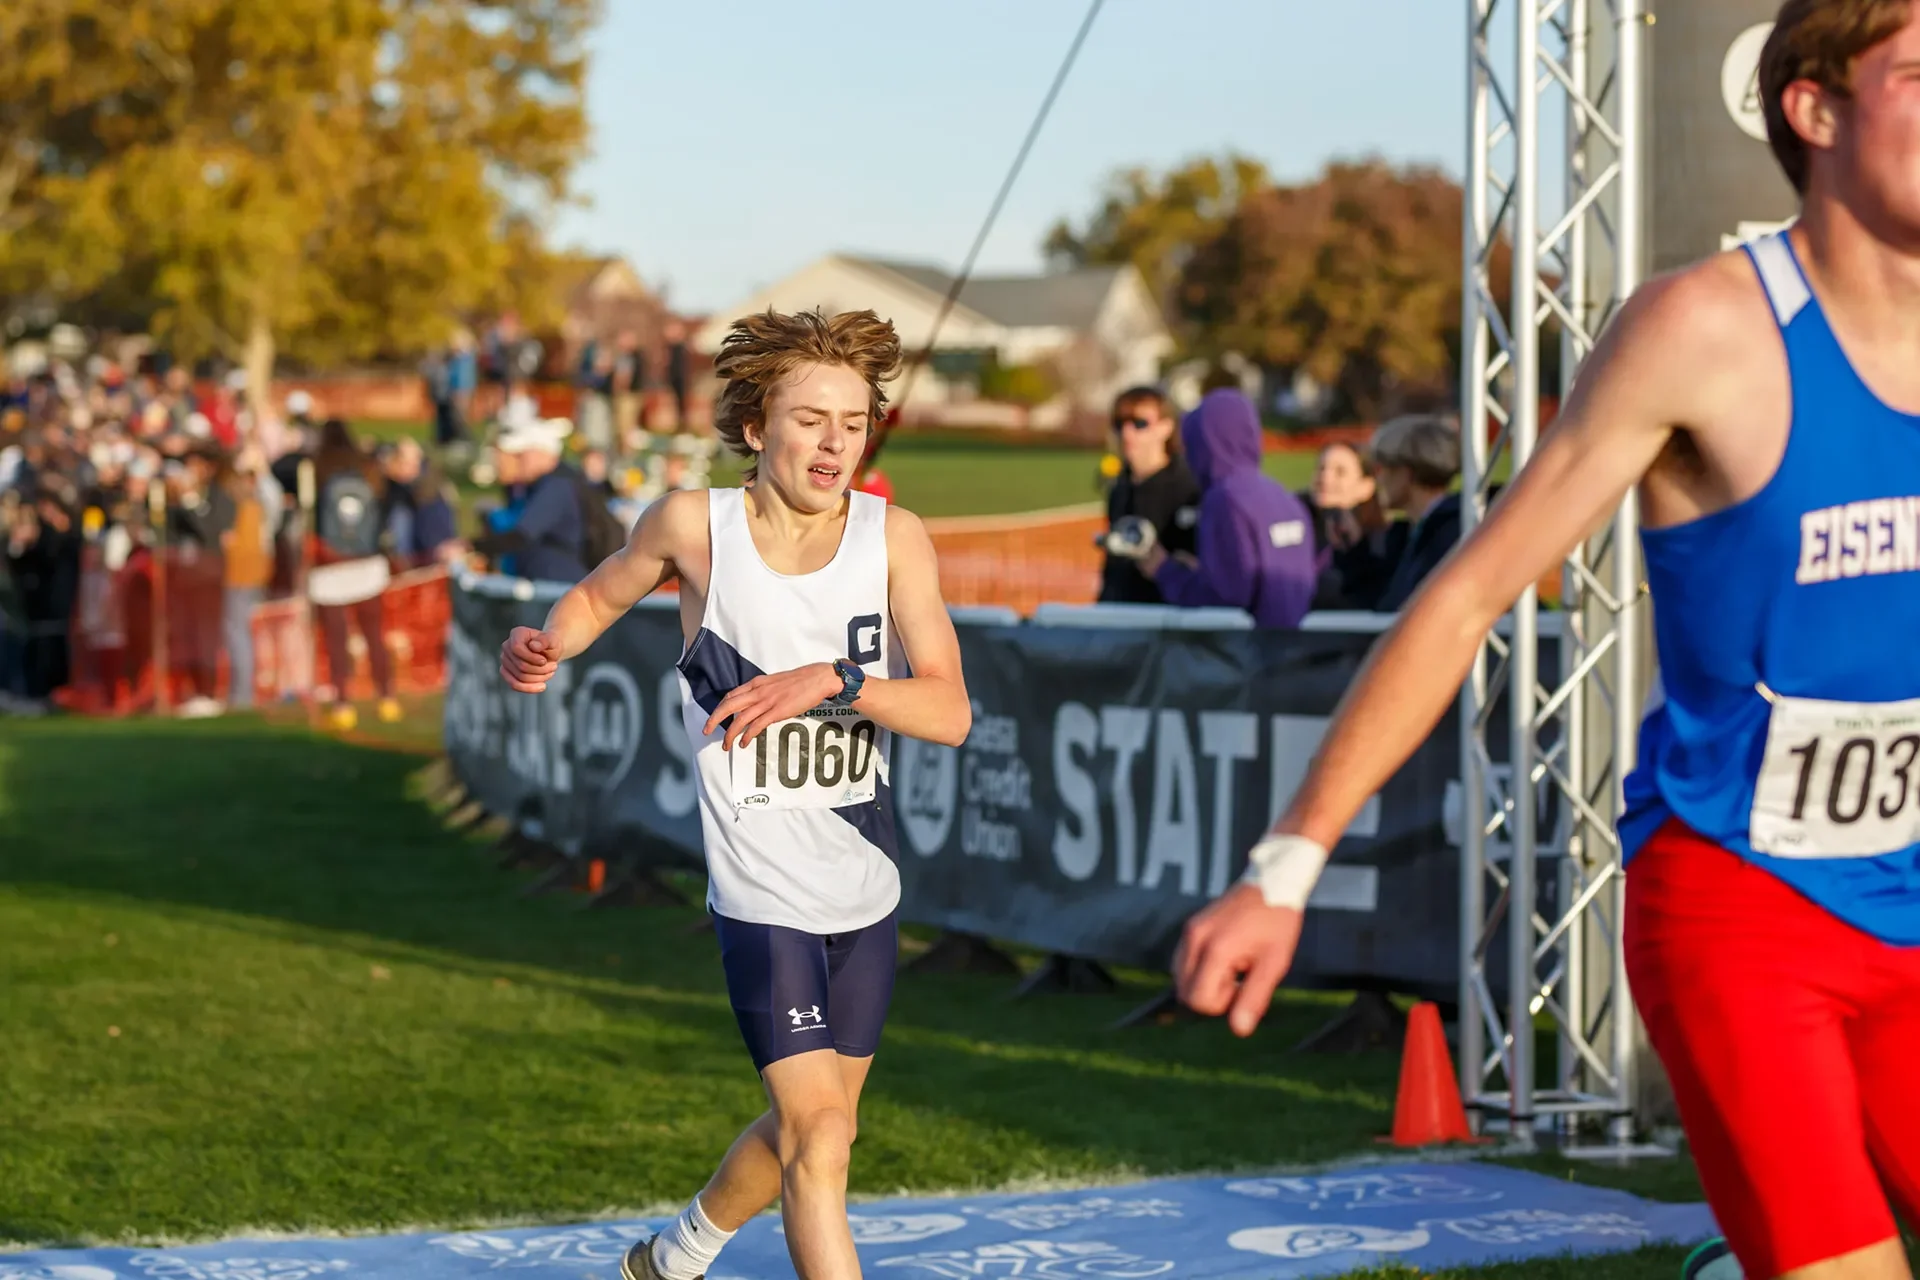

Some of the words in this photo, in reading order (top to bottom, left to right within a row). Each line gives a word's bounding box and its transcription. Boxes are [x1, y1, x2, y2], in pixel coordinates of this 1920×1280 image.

[847, 613, 882, 665] G
[804, 709, 833, 717] CROSS
[836, 707, 860, 716] COUN
[755, 720, 876, 789] 1060
[1788, 733, 1920, 824] 103
